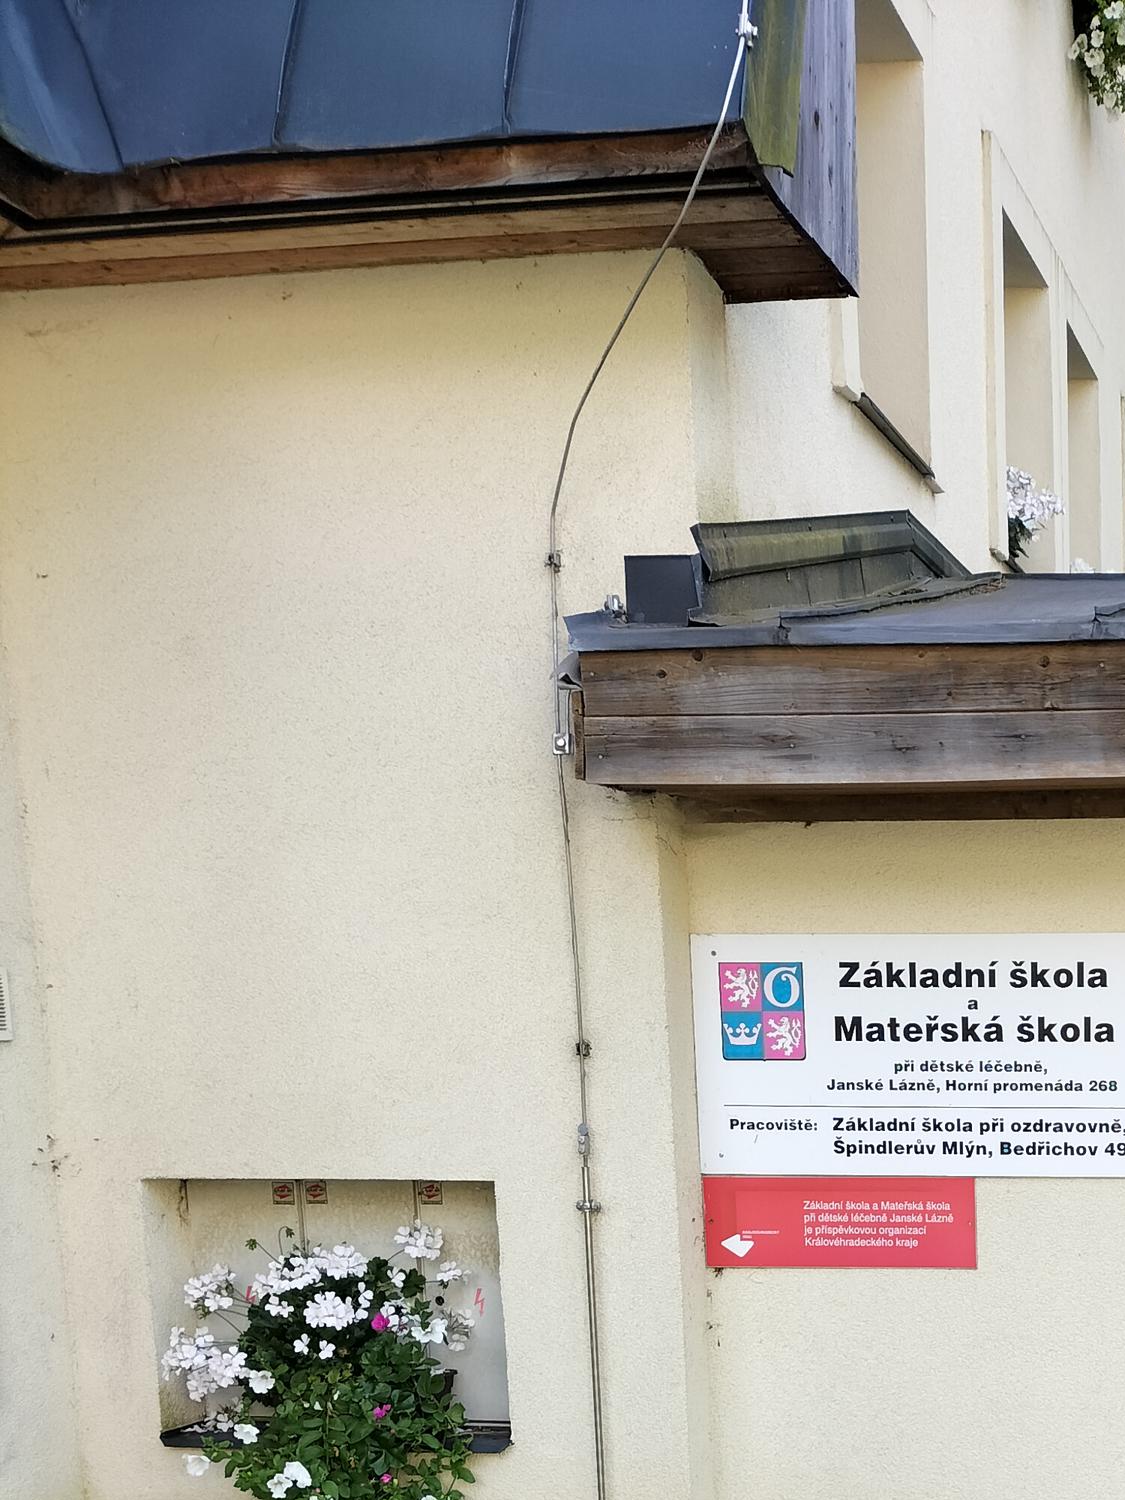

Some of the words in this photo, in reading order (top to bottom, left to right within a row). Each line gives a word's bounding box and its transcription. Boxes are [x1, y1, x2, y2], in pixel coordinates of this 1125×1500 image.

[838, 960, 999, 989] Základní
[1009, 960, 1109, 989] škola
[966, 998, 979, 1012] a
[833, 1015, 1004, 1043] Mateřská
[1016, 1014, 1115, 1043] škola
[893, 1059, 915, 1075] při
[919, 1059, 974, 1073] dětské
[979, 1059, 1048, 1076] léčebně,
[826, 1078, 884, 1092] Janské
[889, 1078, 941, 1094] Lázně,
[945, 1079, 989, 1092] Horní
[993, 1079, 1083, 1094] promenáda
[1088, 1080, 1118, 1092] 268
[729, 1118, 818, 1132] Pracoviště:
[832, 1116, 916, 1132] Základní
[921, 1116, 973, 1133] škola
[979, 1117, 1004, 1136] při
[833, 1136, 936, 1158] Špindlerův
[942, 1139, 993, 1159] Mlýn,
[999, 1140, 1098, 1157] Bedřichov
[803, 1200, 843, 1211] Základní
[845, 1200, 871, 1211] škola
[872, 1202, 879, 1211] a
[880, 1200, 924, 1211] Mateřská
[925, 1200, 951, 1211] škola
[803, 1212, 816, 1224] při
[817, 1212, 849, 1223] dětské
[850, 1212, 888, 1223] léčebně
[889, 1212, 923, 1223] Janské
[925, 1212, 954, 1224] Lázně
[804, 1225, 813, 1237] je
[814, 1224, 877, 1236] příspěvkovou
[878, 1225, 927, 1237] organizací
[804, 1236, 894, 1248] Královéhradeckého
[895, 1237, 919, 1249] kraje
